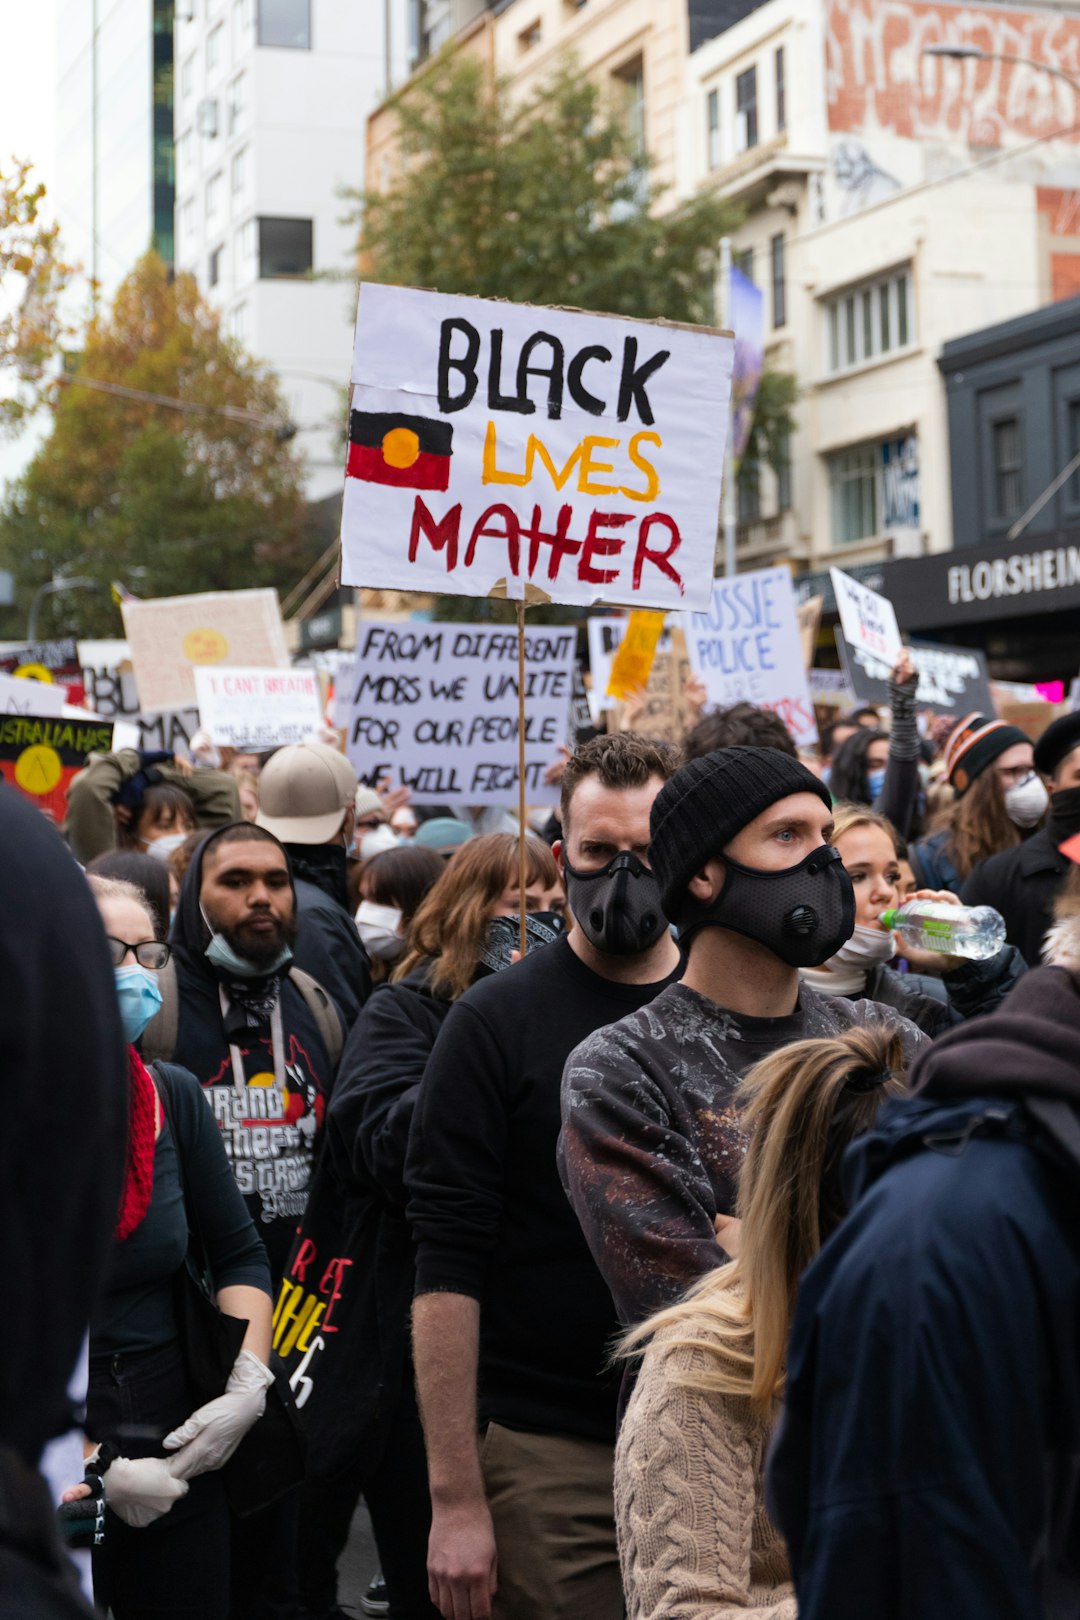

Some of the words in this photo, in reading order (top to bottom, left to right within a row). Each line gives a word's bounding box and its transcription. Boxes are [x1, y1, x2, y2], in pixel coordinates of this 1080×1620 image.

[437, 317, 670, 425] BLACK
[482, 420, 662, 502] LIVES
[408, 495, 685, 597] MATTER
[360, 628, 443, 663] FROM
[452, 632, 572, 663] DIFFERENT
[697, 631, 775, 674] POLICE
[353, 673, 422, 705] MOBS
[429, 676, 467, 700] WE
[483, 671, 566, 701] UNITE
[351, 716, 400, 750] FOR
[414, 719, 463, 747] OUR
[398, 766, 462, 794] WILL
[470, 763, 547, 794] FIGHT
